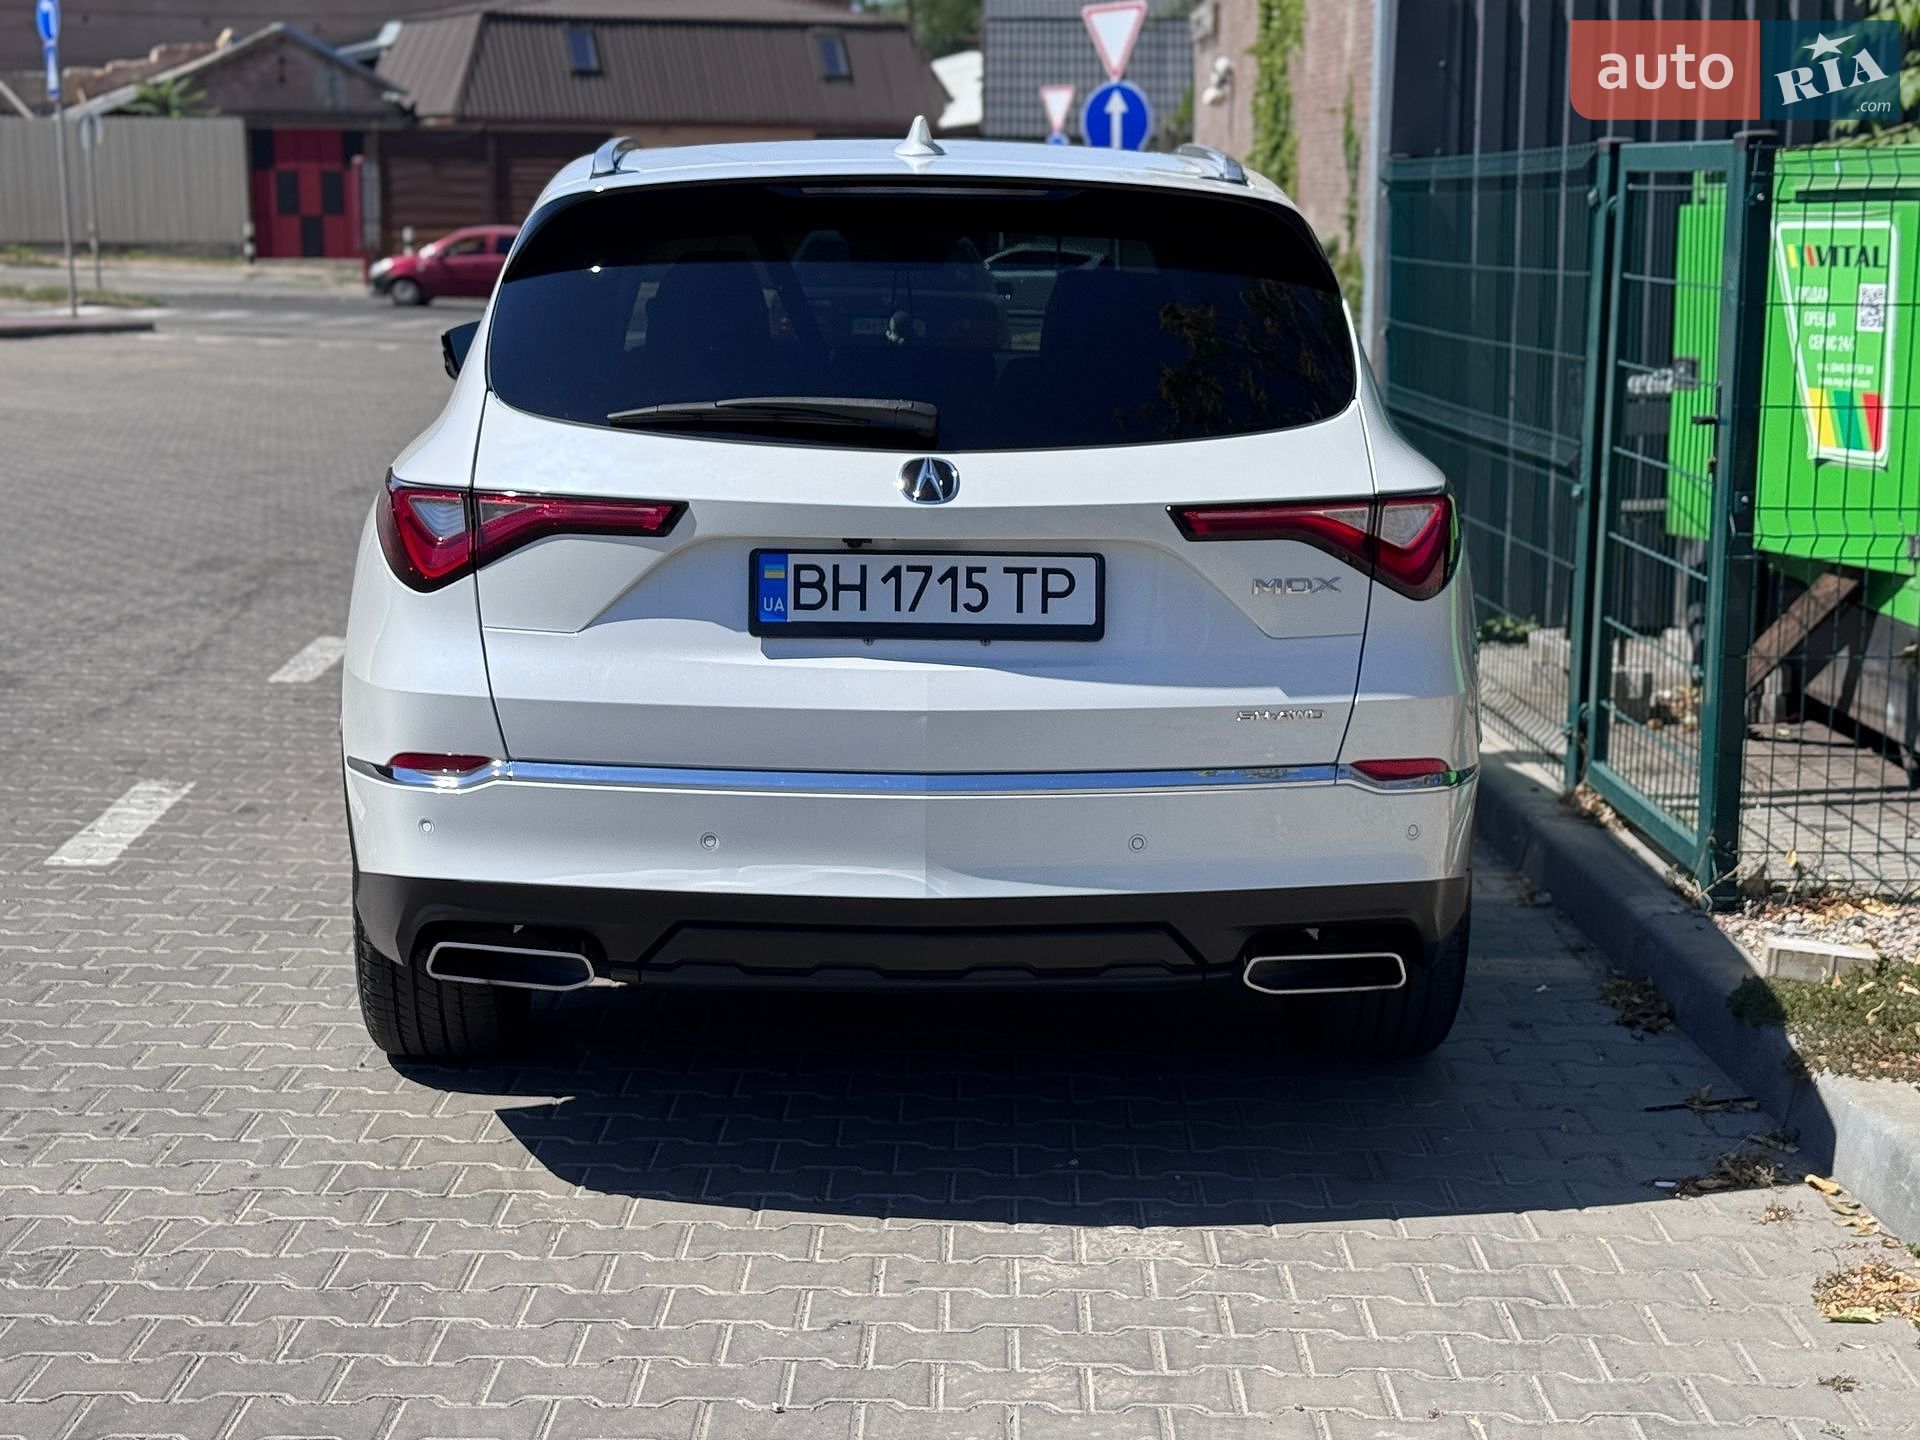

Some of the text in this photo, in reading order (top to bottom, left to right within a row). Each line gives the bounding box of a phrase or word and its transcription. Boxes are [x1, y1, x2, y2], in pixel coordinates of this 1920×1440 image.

[1815, 245, 1888, 268] VITAL
[793, 564, 1076, 614] BH 1715 TP
[1251, 576, 1342, 595] MDX
[763, 597, 785, 612] UA
